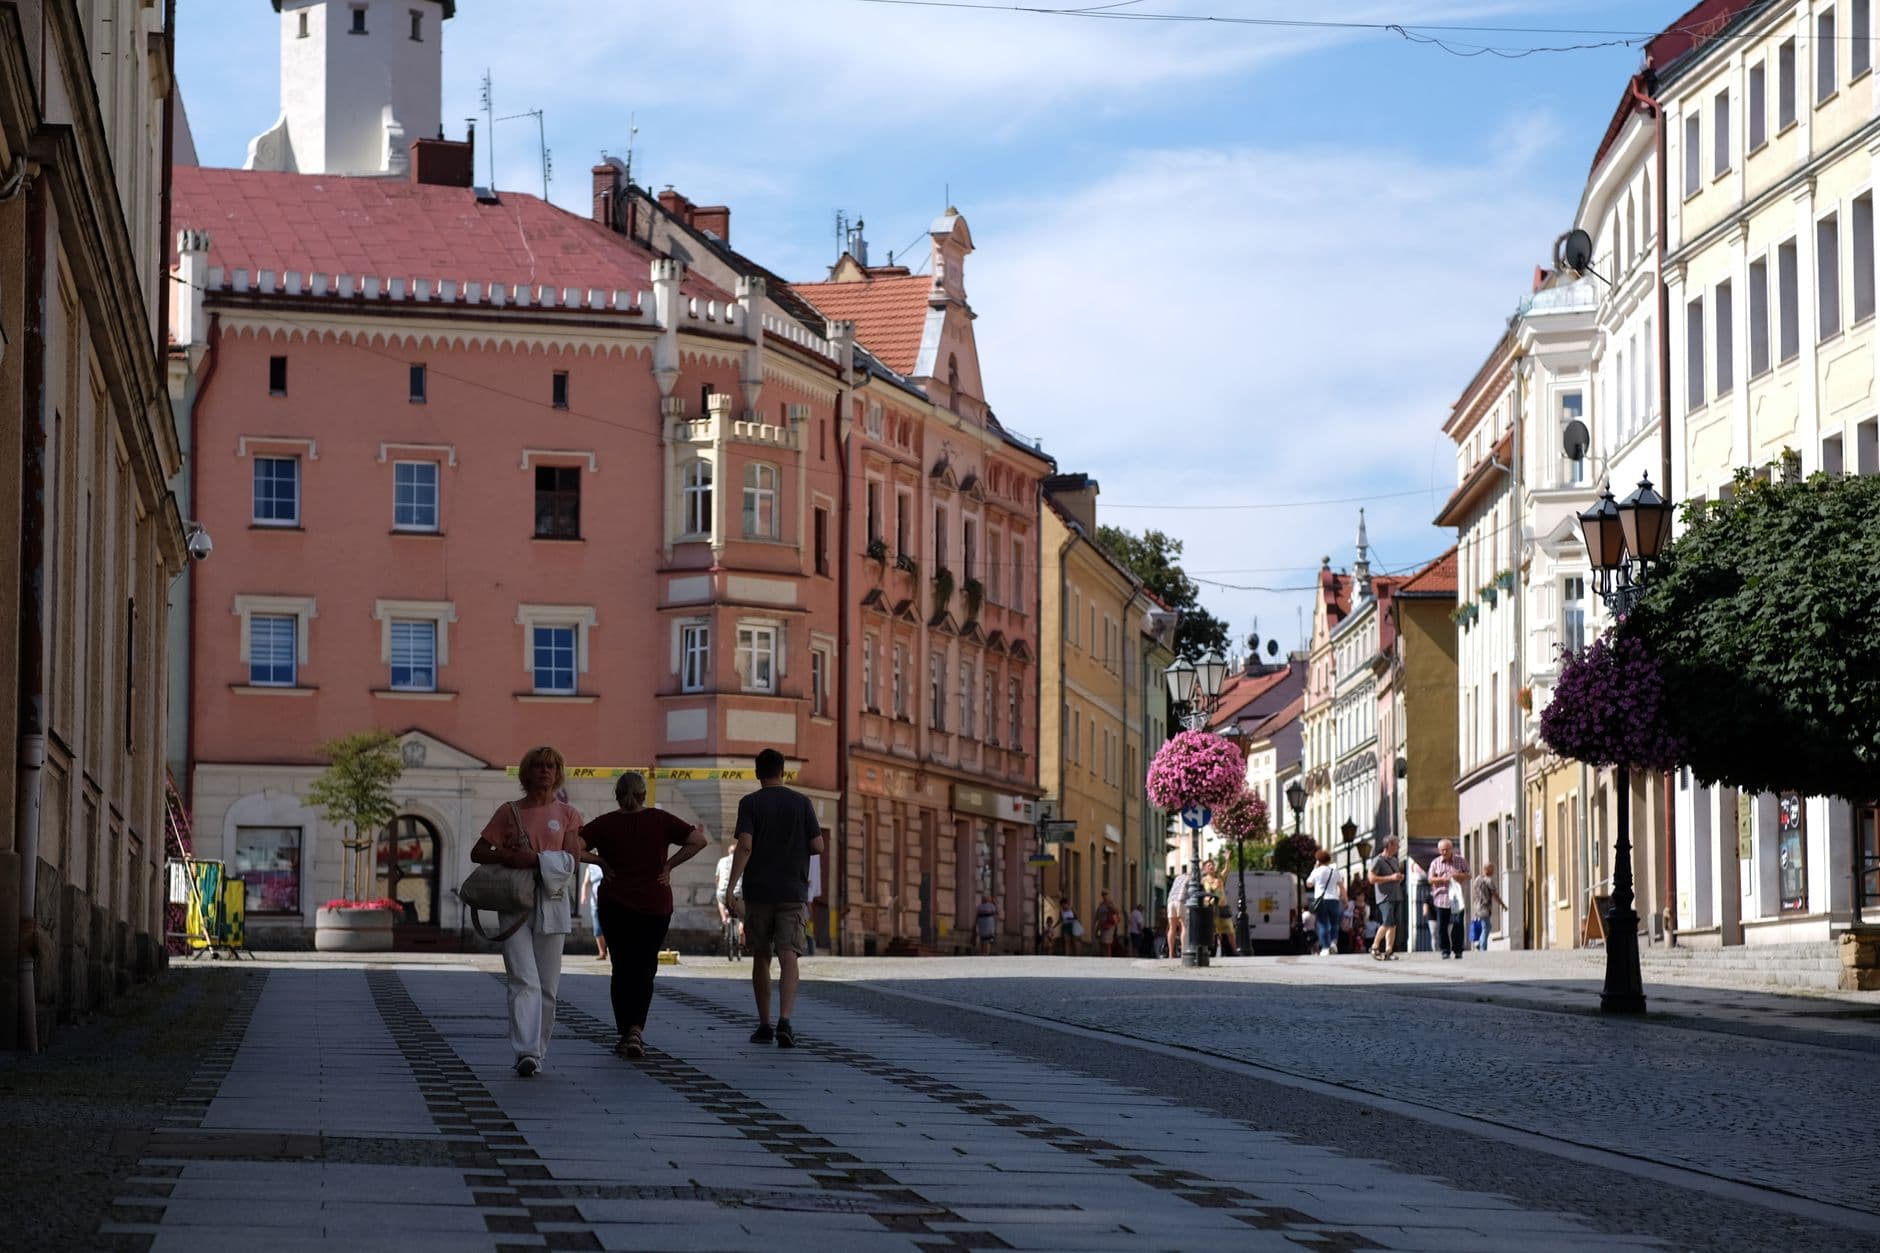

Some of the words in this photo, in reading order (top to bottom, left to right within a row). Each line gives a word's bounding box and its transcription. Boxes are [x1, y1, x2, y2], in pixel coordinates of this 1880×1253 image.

[573, 768, 595, 777] RPK
[670, 770, 692, 779] RPK
[721, 770, 744, 780] RPK
